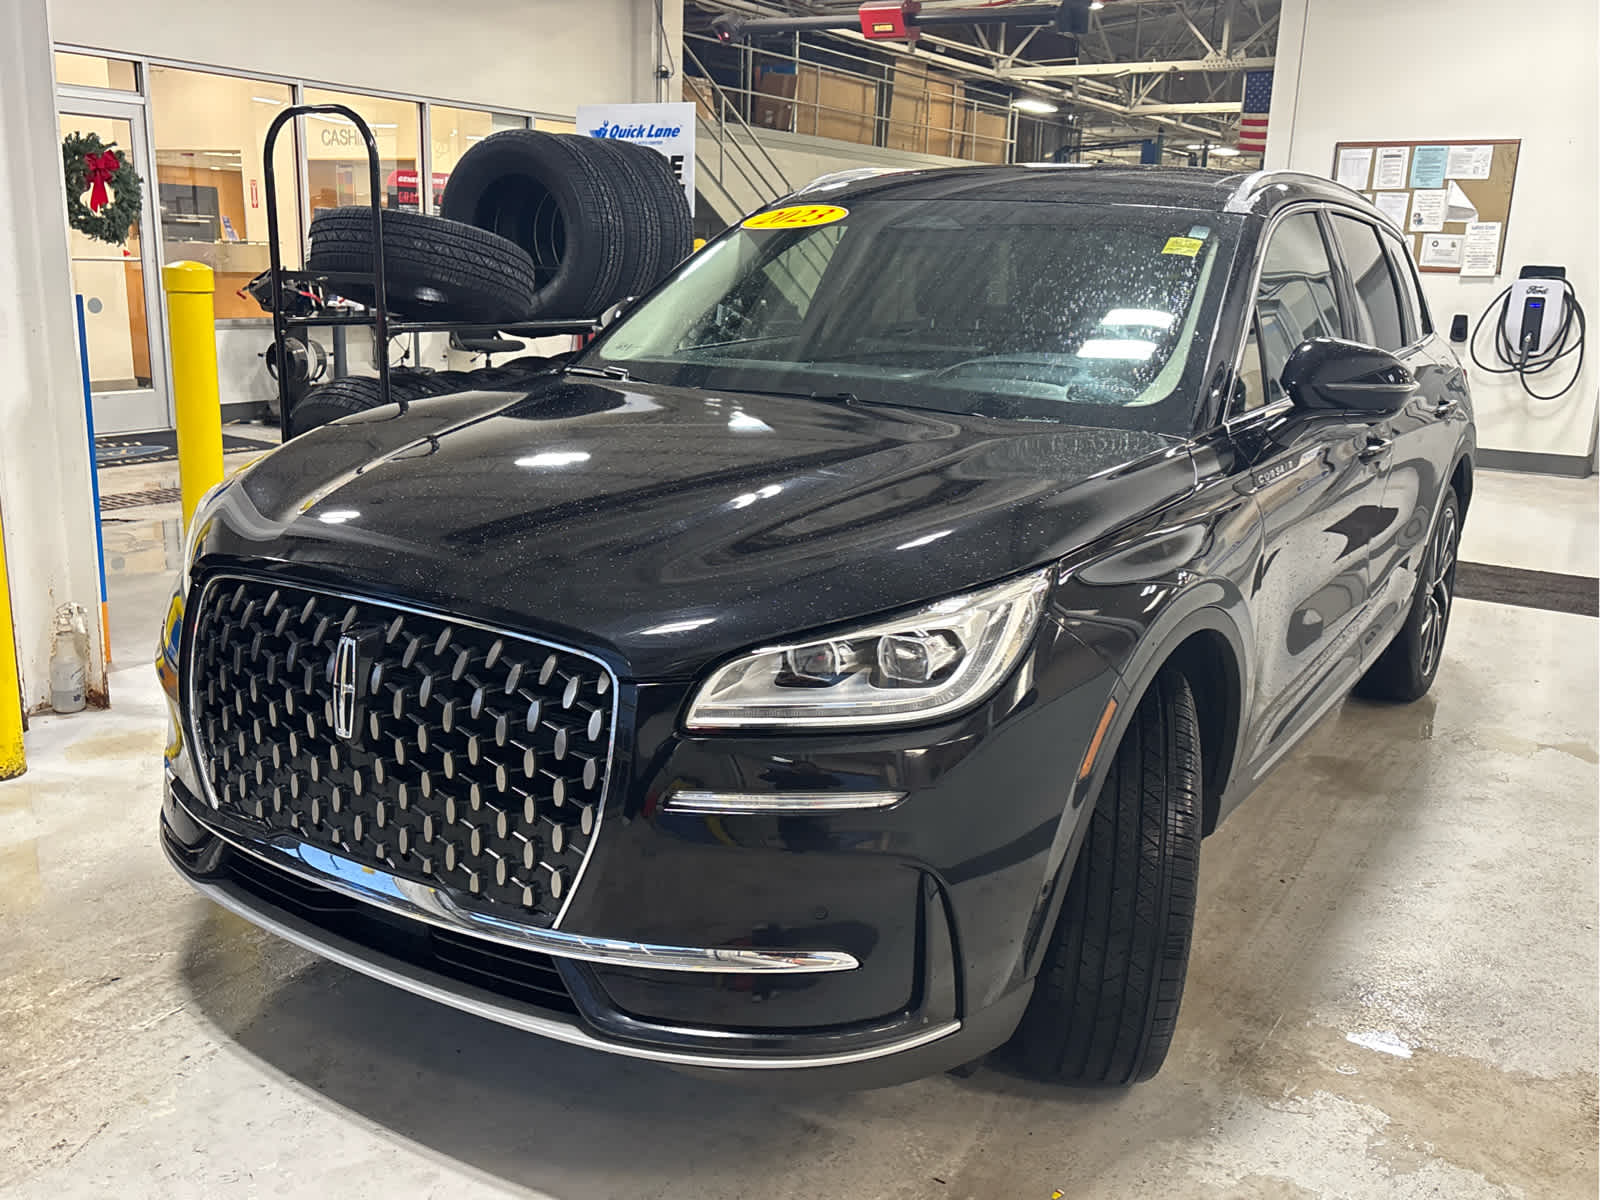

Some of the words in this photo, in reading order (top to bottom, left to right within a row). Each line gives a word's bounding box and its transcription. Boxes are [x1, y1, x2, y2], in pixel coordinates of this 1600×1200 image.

[609, 124, 645, 139] Quick
[647, 124, 680, 138] Lane
[1526, 285, 1550, 294] Ford
